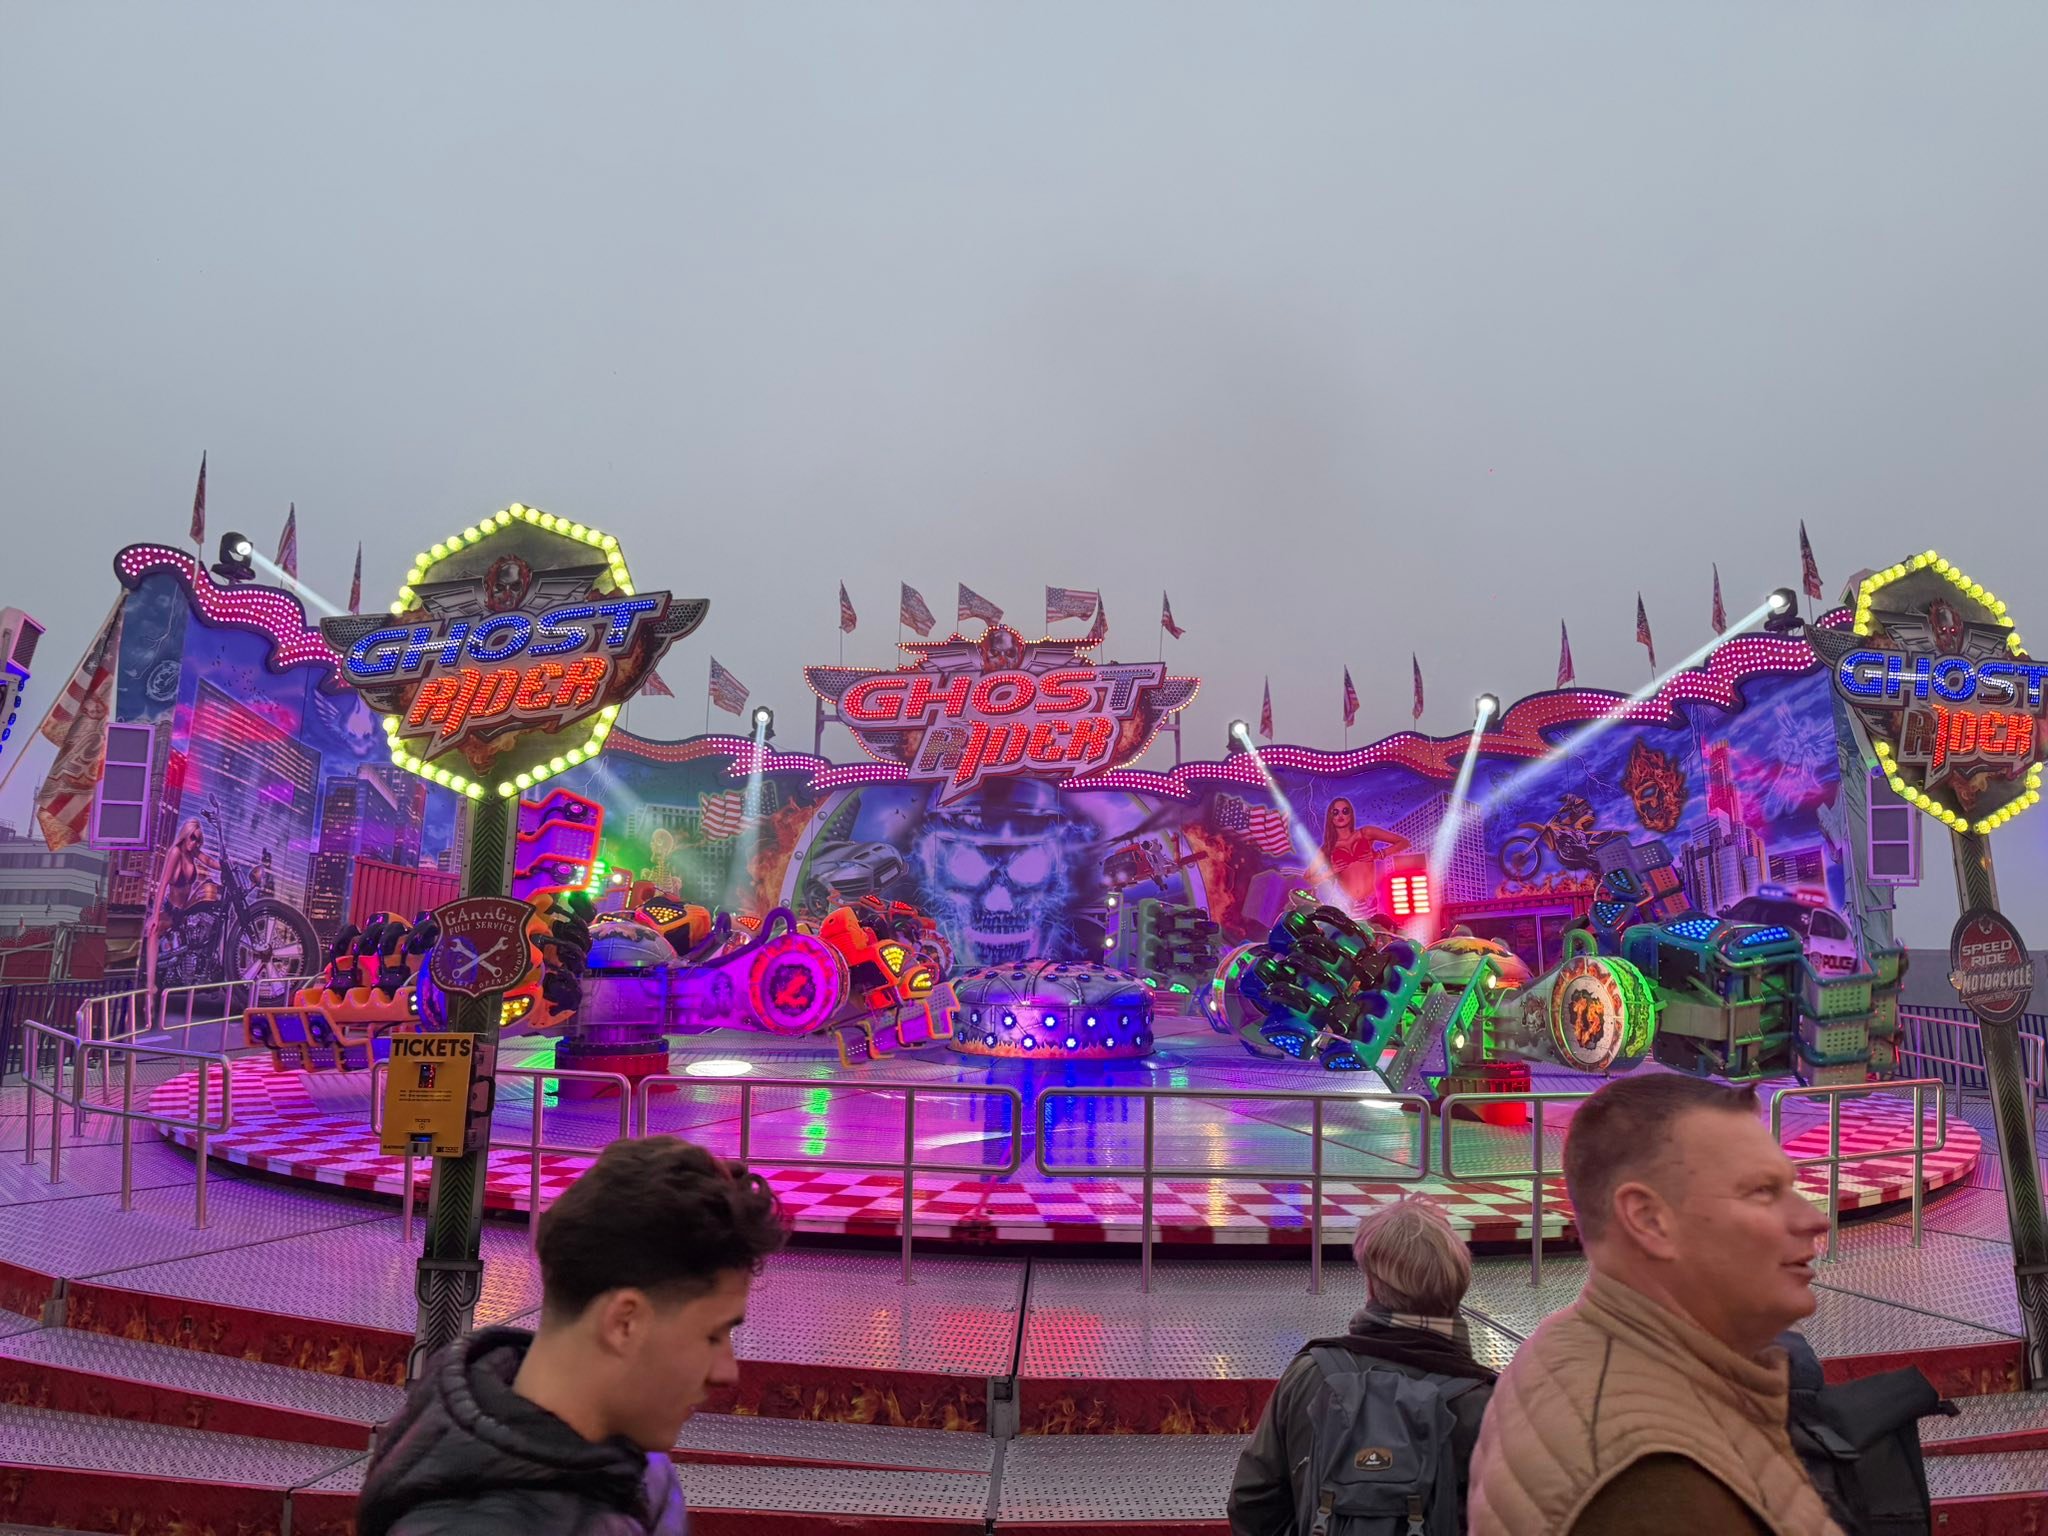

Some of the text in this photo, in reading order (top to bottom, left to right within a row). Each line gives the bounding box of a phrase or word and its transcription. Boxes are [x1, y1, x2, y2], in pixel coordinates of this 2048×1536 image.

[346, 598, 657, 677] GHOST
[1839, 651, 2048, 705] GHOST
[408, 656, 608, 737] RIDER
[843, 669, 1156, 720] GHOST
[1905, 703, 2034, 769] RIDER
[918, 716, 1113, 785] RIDER
[444, 906, 517, 926] GARAGE
[449, 921, 515, 936] FULL SERVICE
[1961, 939, 2013, 957] SPEED
[1970, 951, 2007, 967] RIDE
[1823, 954, 1855, 970] POLICE
[478, 978, 502, 989] OPEN
[1961, 962, 2033, 995] MOTORCYCLE
[392, 1038, 471, 1057] TICKETS
